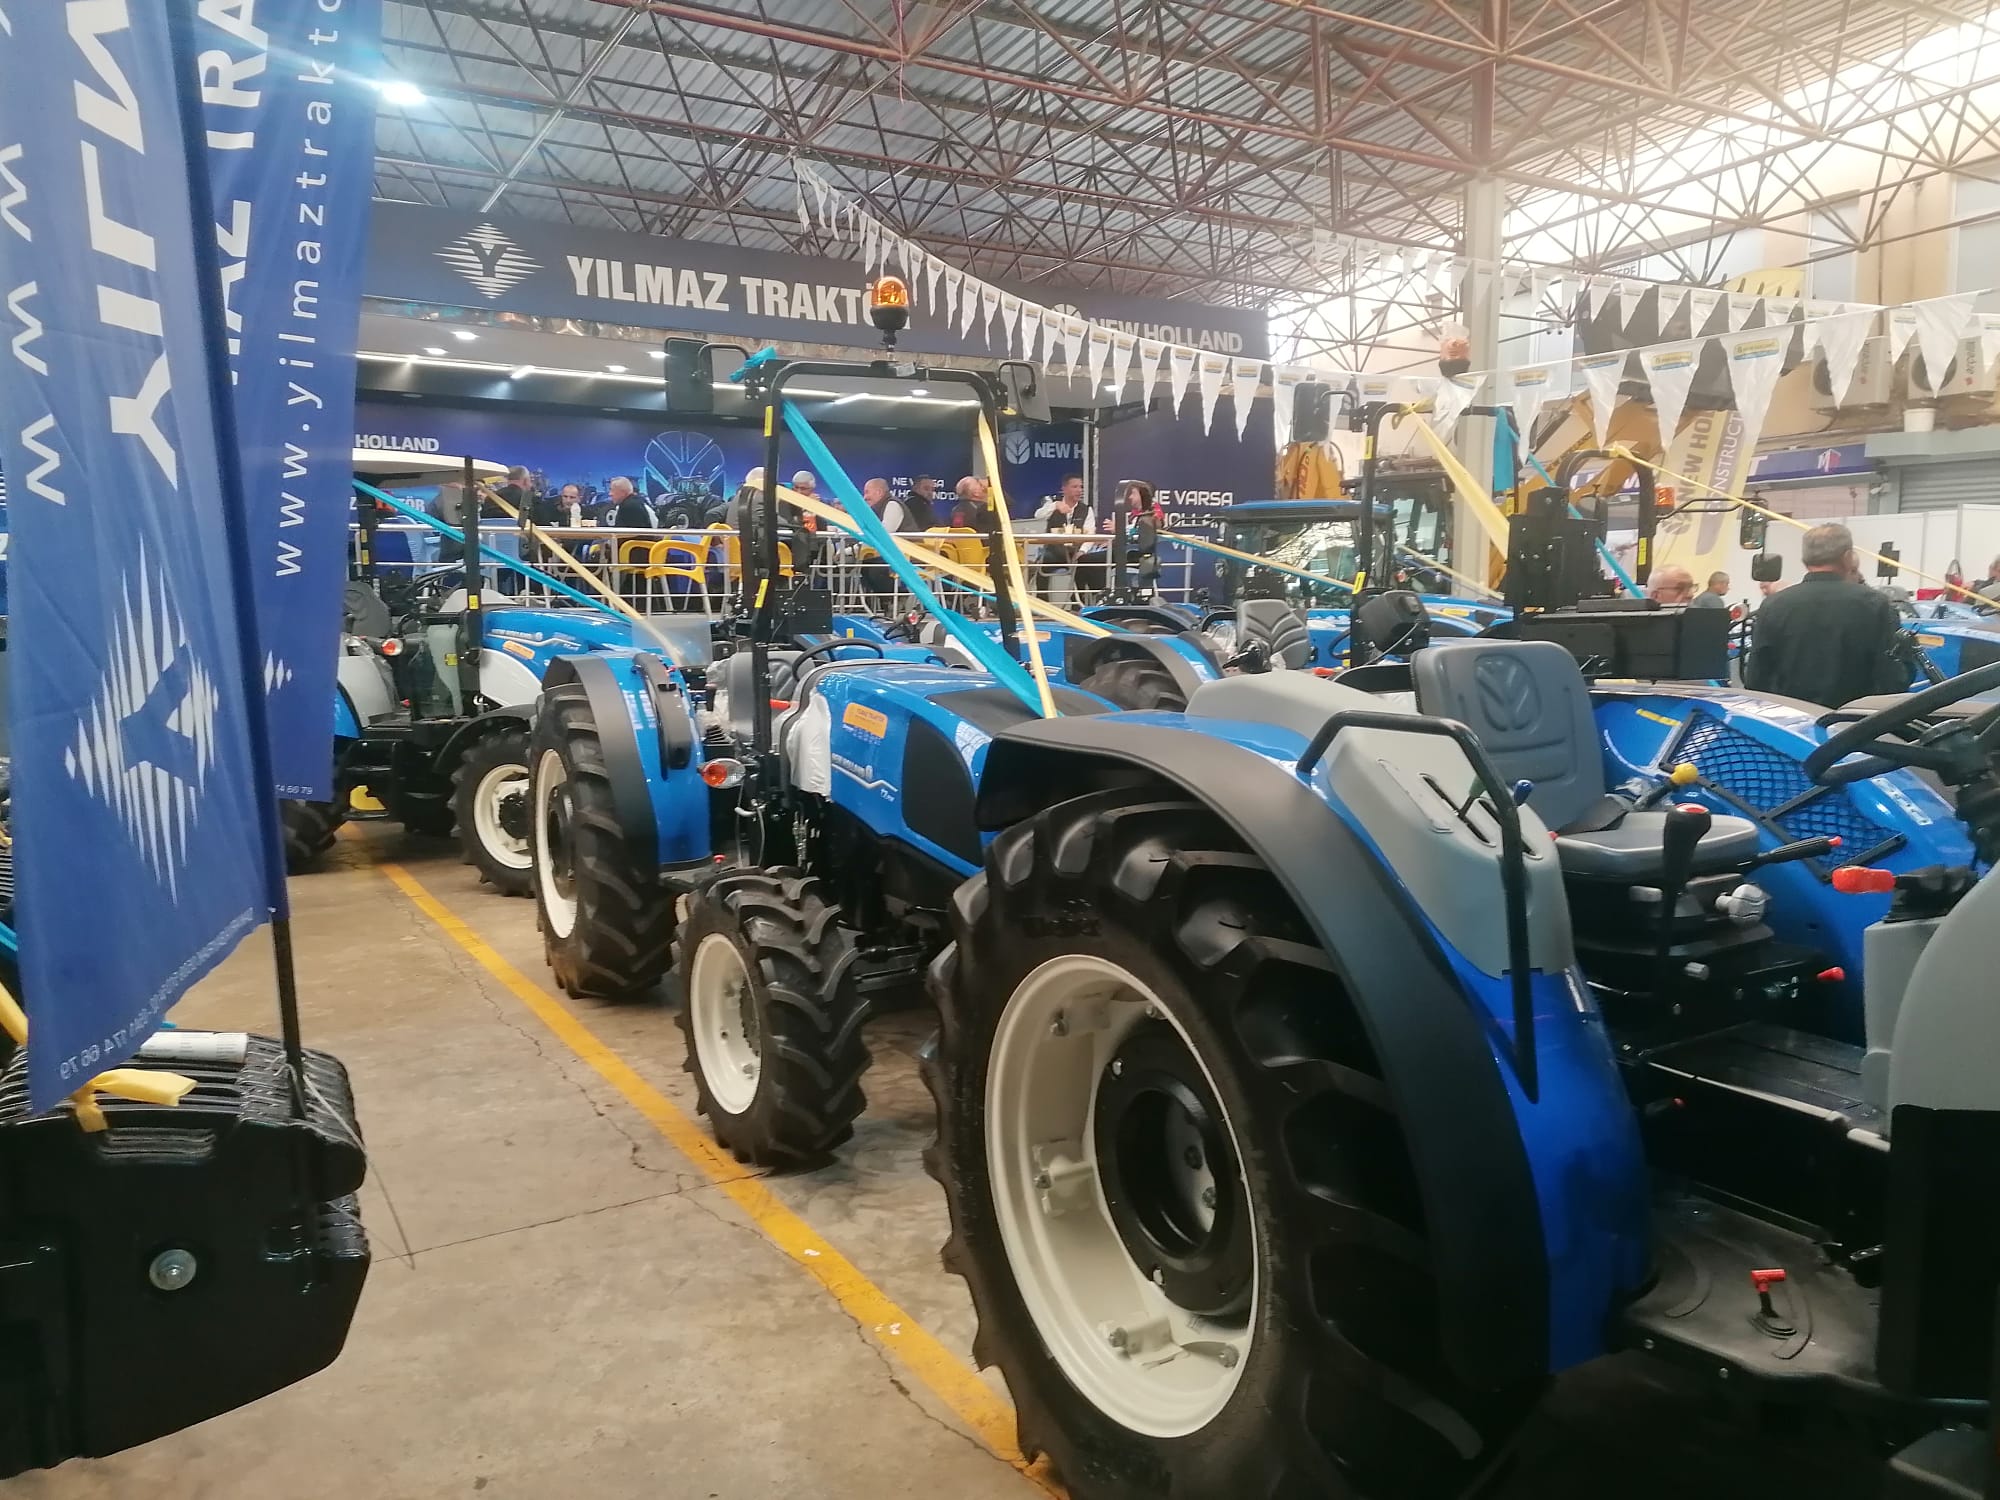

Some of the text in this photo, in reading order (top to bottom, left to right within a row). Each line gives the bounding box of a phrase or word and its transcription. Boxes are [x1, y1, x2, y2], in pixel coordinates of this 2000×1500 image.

[566, 255, 911, 330] YILMAZ TRAKT
[1143, 324, 1243, 353] HOLLAND
[355, 434, 440, 452] HOLLAND
[1034, 442, 1071, 458] NEW
[1174, 490, 1233, 506] VARSA
